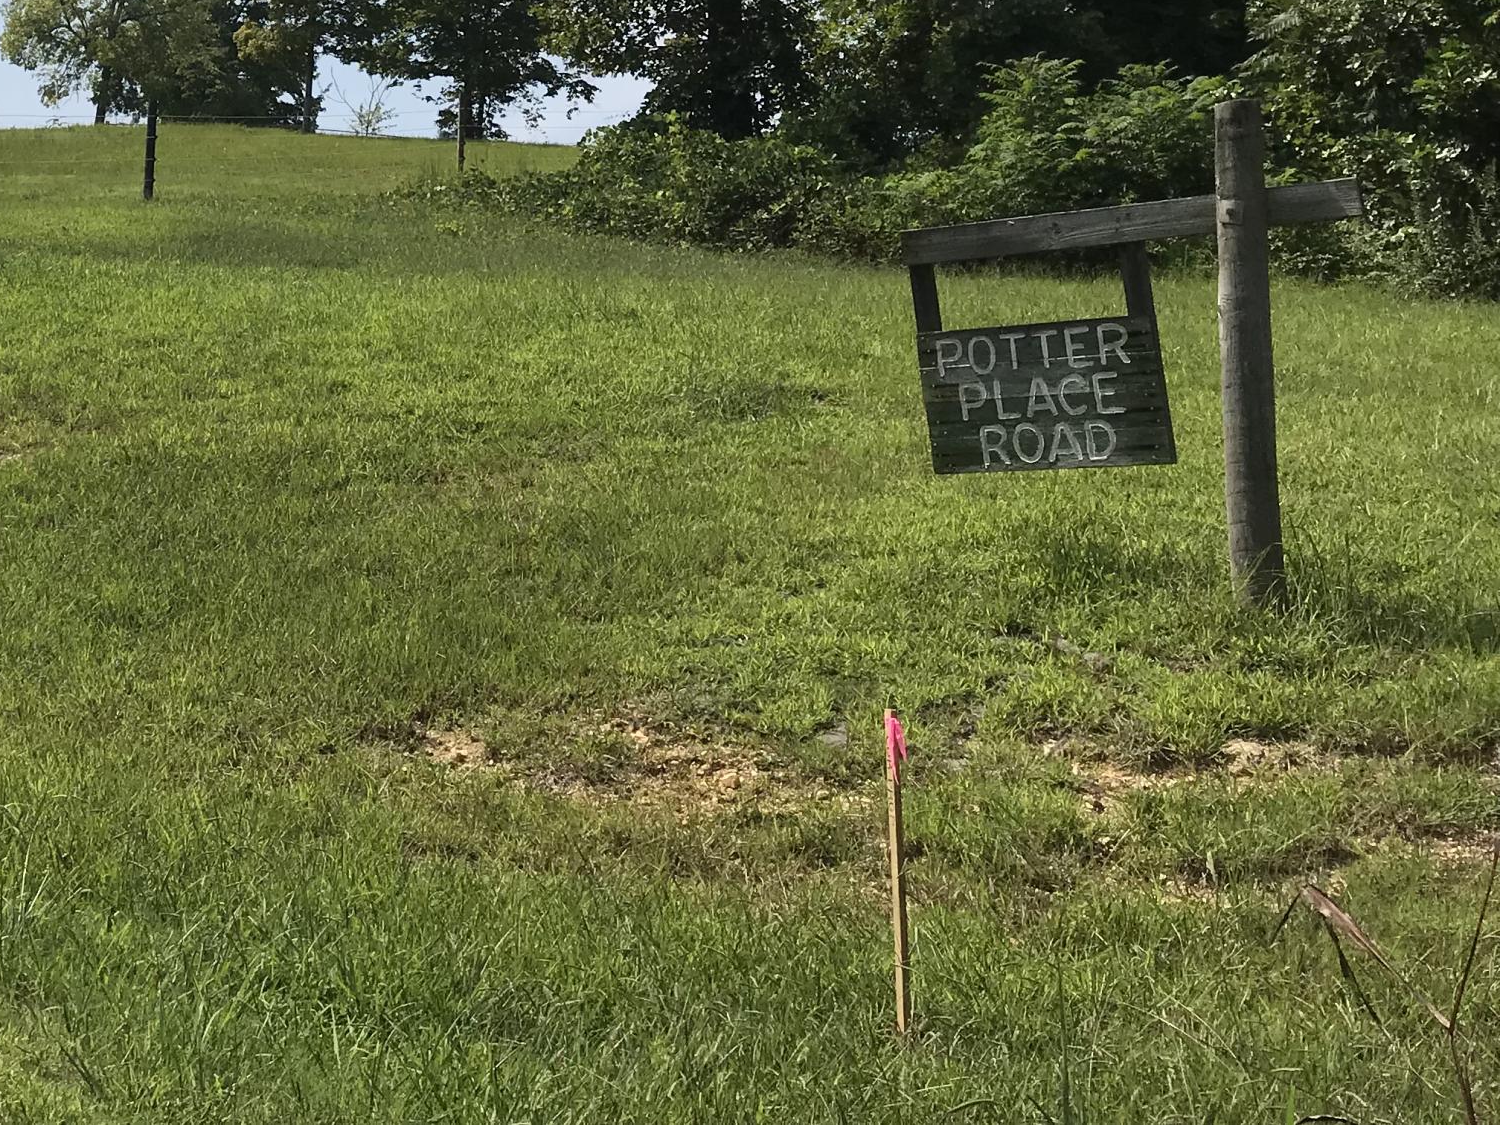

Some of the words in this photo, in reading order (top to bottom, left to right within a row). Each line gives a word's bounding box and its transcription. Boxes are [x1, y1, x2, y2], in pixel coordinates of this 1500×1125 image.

[936, 323, 1131, 377] POTTER
[959, 372, 1127, 421] PLACE
[980, 420, 1116, 468] ROAD
